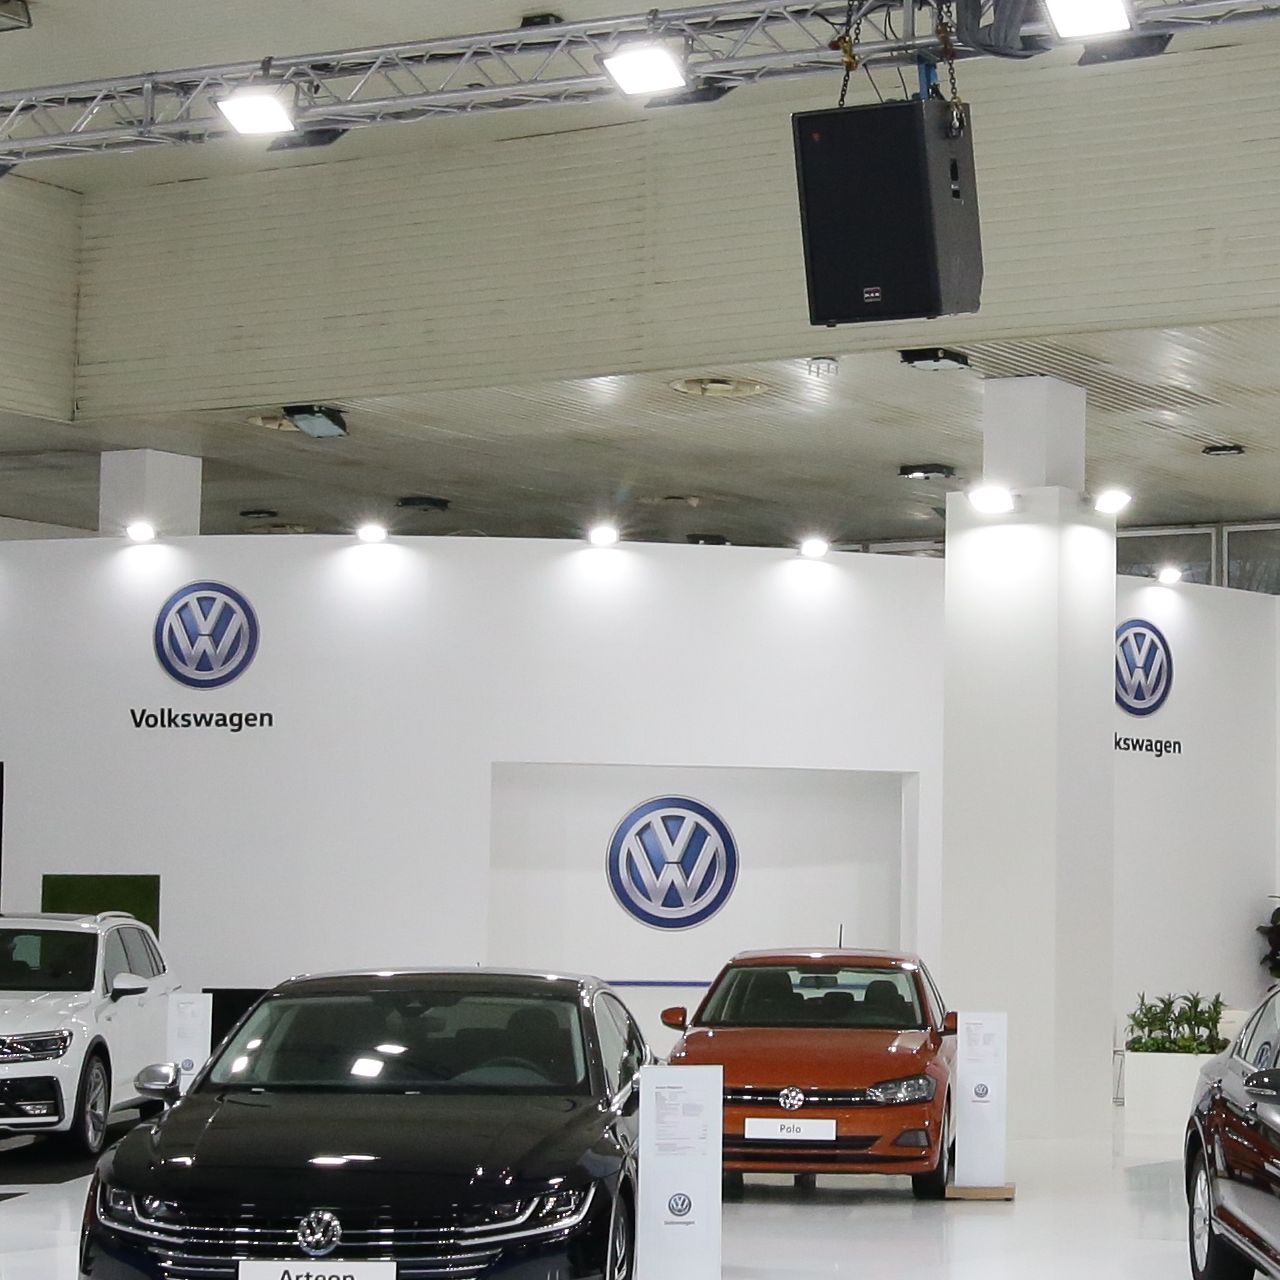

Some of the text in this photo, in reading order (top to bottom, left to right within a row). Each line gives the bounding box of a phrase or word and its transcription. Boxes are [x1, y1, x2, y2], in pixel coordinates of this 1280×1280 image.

[130, 708, 273, 732] Volkswagen
[1114, 732, 1182, 758] kswagen
[780, 1124, 802, 1134] Polo
